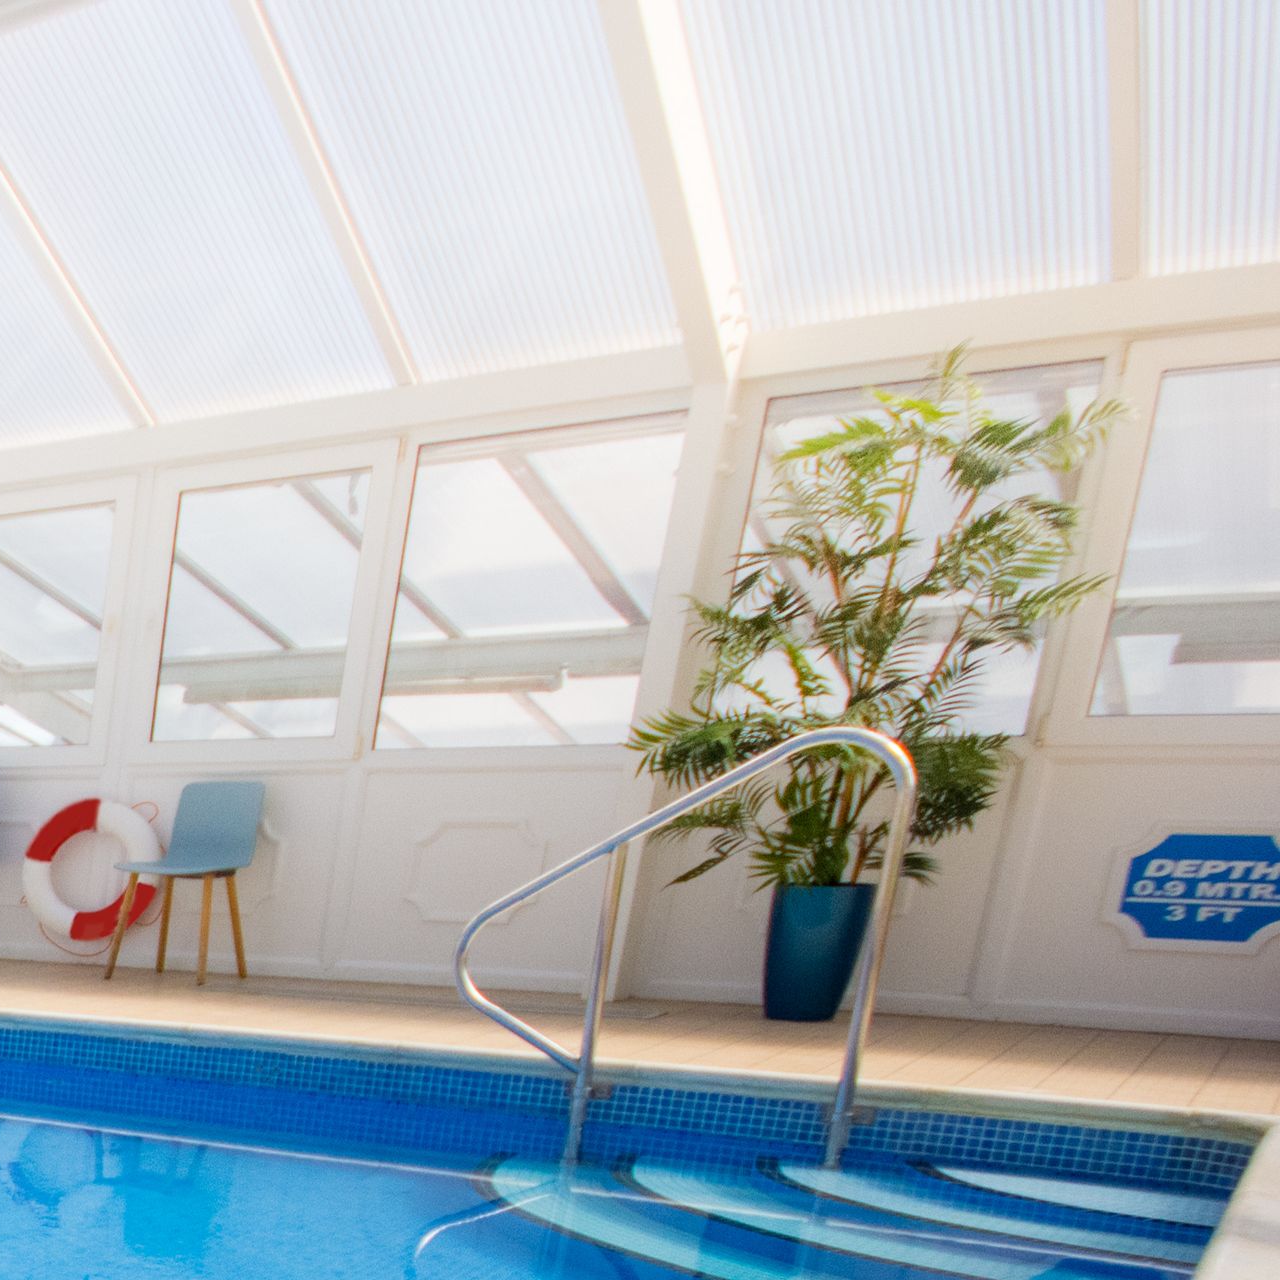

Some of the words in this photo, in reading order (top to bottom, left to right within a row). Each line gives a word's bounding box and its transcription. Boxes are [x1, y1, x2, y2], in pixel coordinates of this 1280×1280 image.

[1143, 858, 1280, 881] DEPTH
[1132, 880, 1186, 896] 0.9
[1165, 904, 1186, 921] 3
[1196, 906, 1244, 923] FT
